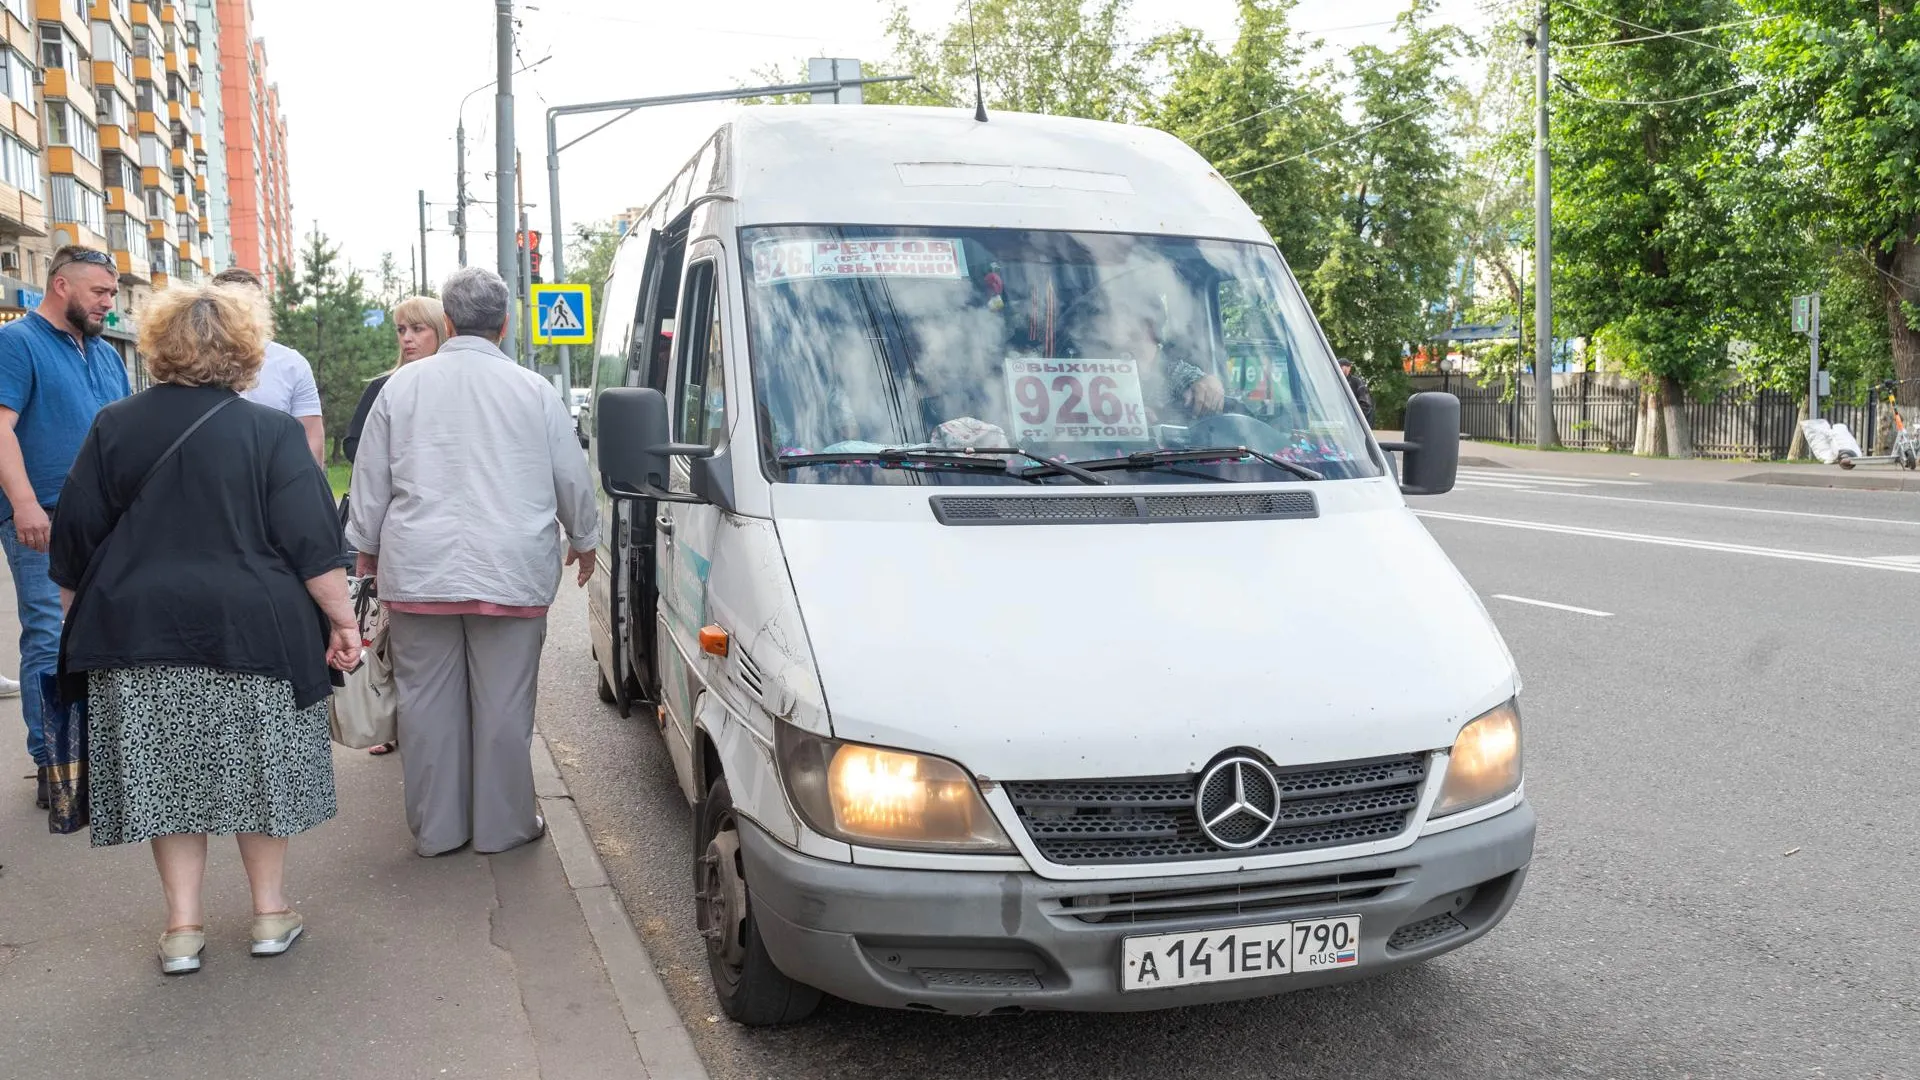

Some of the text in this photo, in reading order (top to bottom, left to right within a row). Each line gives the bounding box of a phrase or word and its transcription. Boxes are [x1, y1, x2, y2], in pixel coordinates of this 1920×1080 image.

[817, 241, 952, 255] РЕУТОВ
[837, 262, 954, 273] ВЫХИНО
[1026, 362, 1132, 373] ВЫХИНО
[1055, 426, 1144, 437] РЕУТОВО
[1295, 922, 1349, 955] 790
[1309, 952, 1336, 966] RUS
